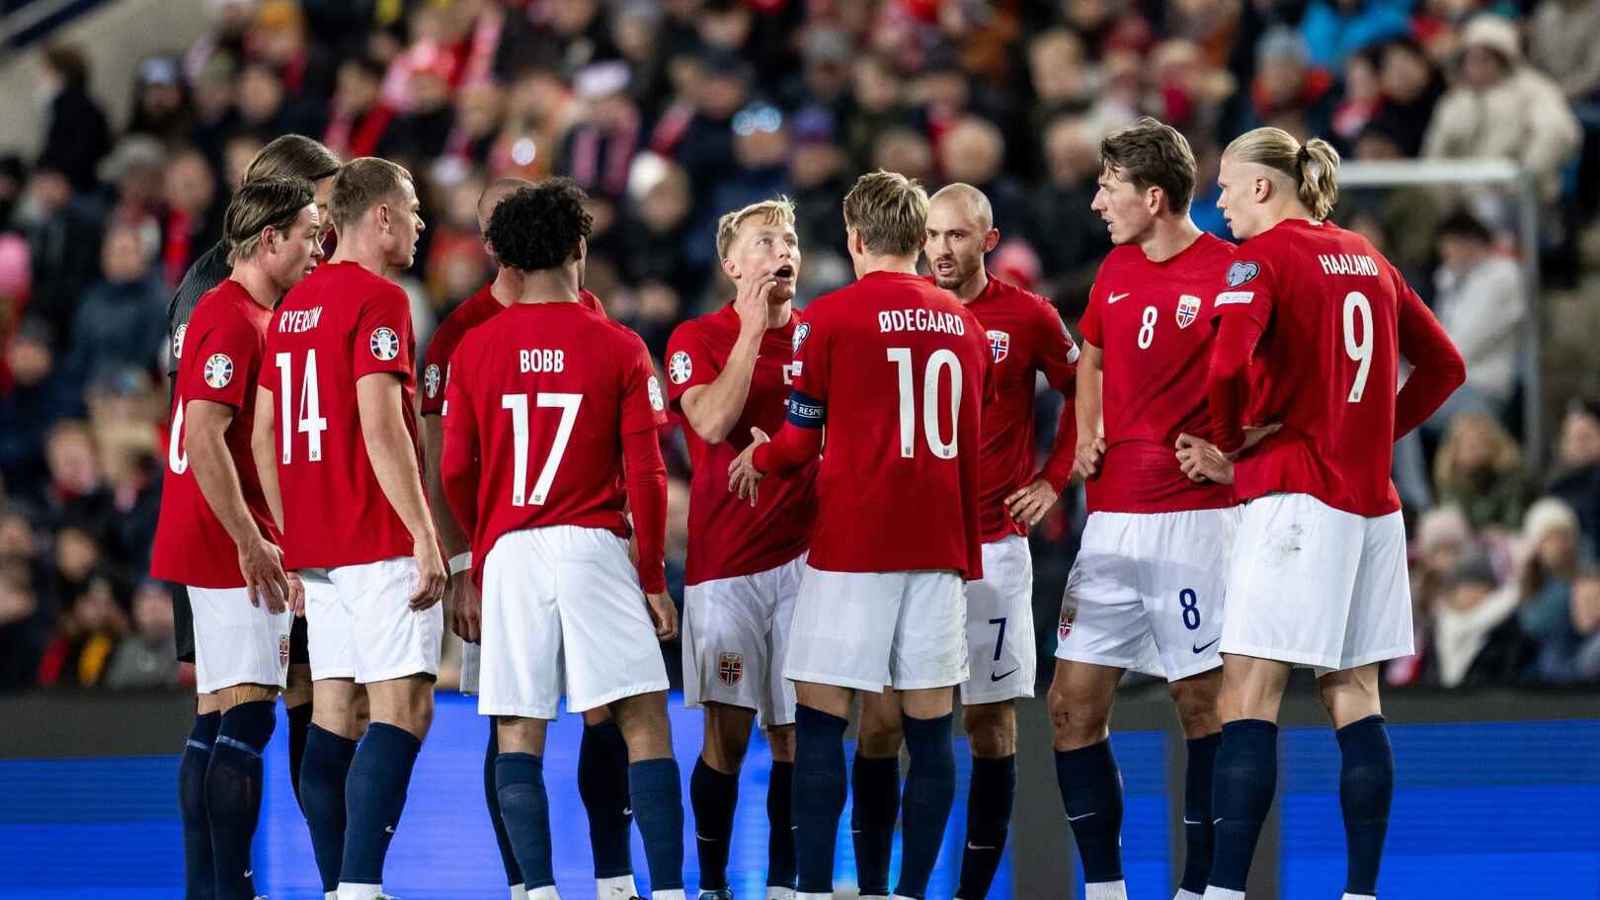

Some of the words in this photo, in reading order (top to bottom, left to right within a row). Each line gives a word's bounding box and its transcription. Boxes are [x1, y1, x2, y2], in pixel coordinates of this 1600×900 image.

[1317, 253, 1379, 276] HAALAND
[878, 308, 965, 337] ØDEGAARD
[1137, 305, 1158, 350] 8
[519, 349, 565, 373] BOBB
[1342, 291, 1374, 404] 9
[275, 348, 328, 466] 14
[886, 347, 963, 460] 10
[501, 392, 584, 507] 17
[1179, 588, 1201, 631] 8
[988, 616, 1007, 661] 7
